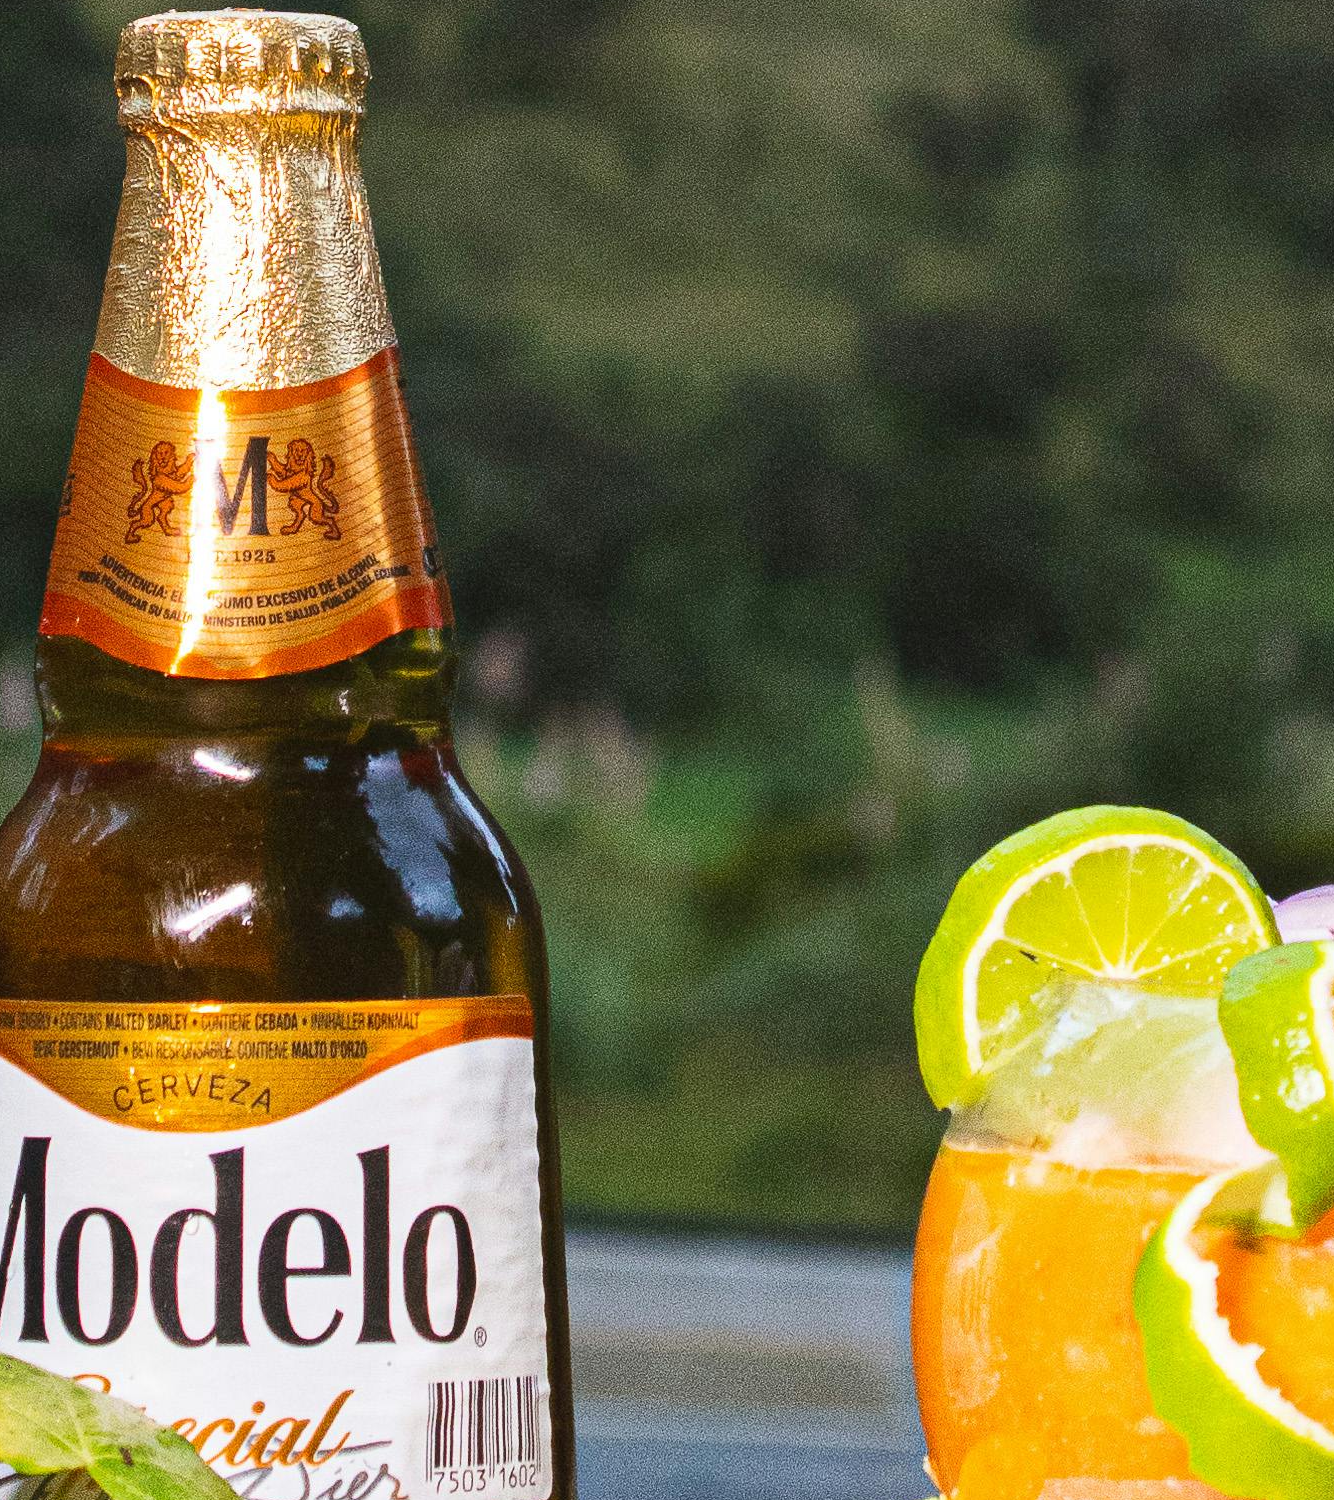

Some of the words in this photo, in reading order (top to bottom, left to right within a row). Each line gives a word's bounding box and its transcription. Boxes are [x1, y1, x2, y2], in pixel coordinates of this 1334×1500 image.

[235, 550, 275, 563] 1925
[100, 554, 167, 599] ADVERTENCIA:
[256, 586, 317, 609] EXCESIVO
[317, 581, 337, 596] DE
[148, 604, 163, 618] SU
[203, 614, 266, 627] MINISTERIO
[269, 612, 284, 625] DE
[285, 604, 320, 622] SALUD
[105, 1011, 144, 1030] MALTED
[148, 1012, 188, 1030] BARLEY
[201, 1012, 251, 1031] CONTIENE
[255, 1012, 298, 1031] CEBADA
[238, 1041, 288, 1059] CONTIENE
[291, 1040, 326, 1058] MALTO
[112, 1073, 272, 1113] CERVEZA
[434, 1469, 487, 1494] 7503
[499, 1464, 537, 1490] 1602
